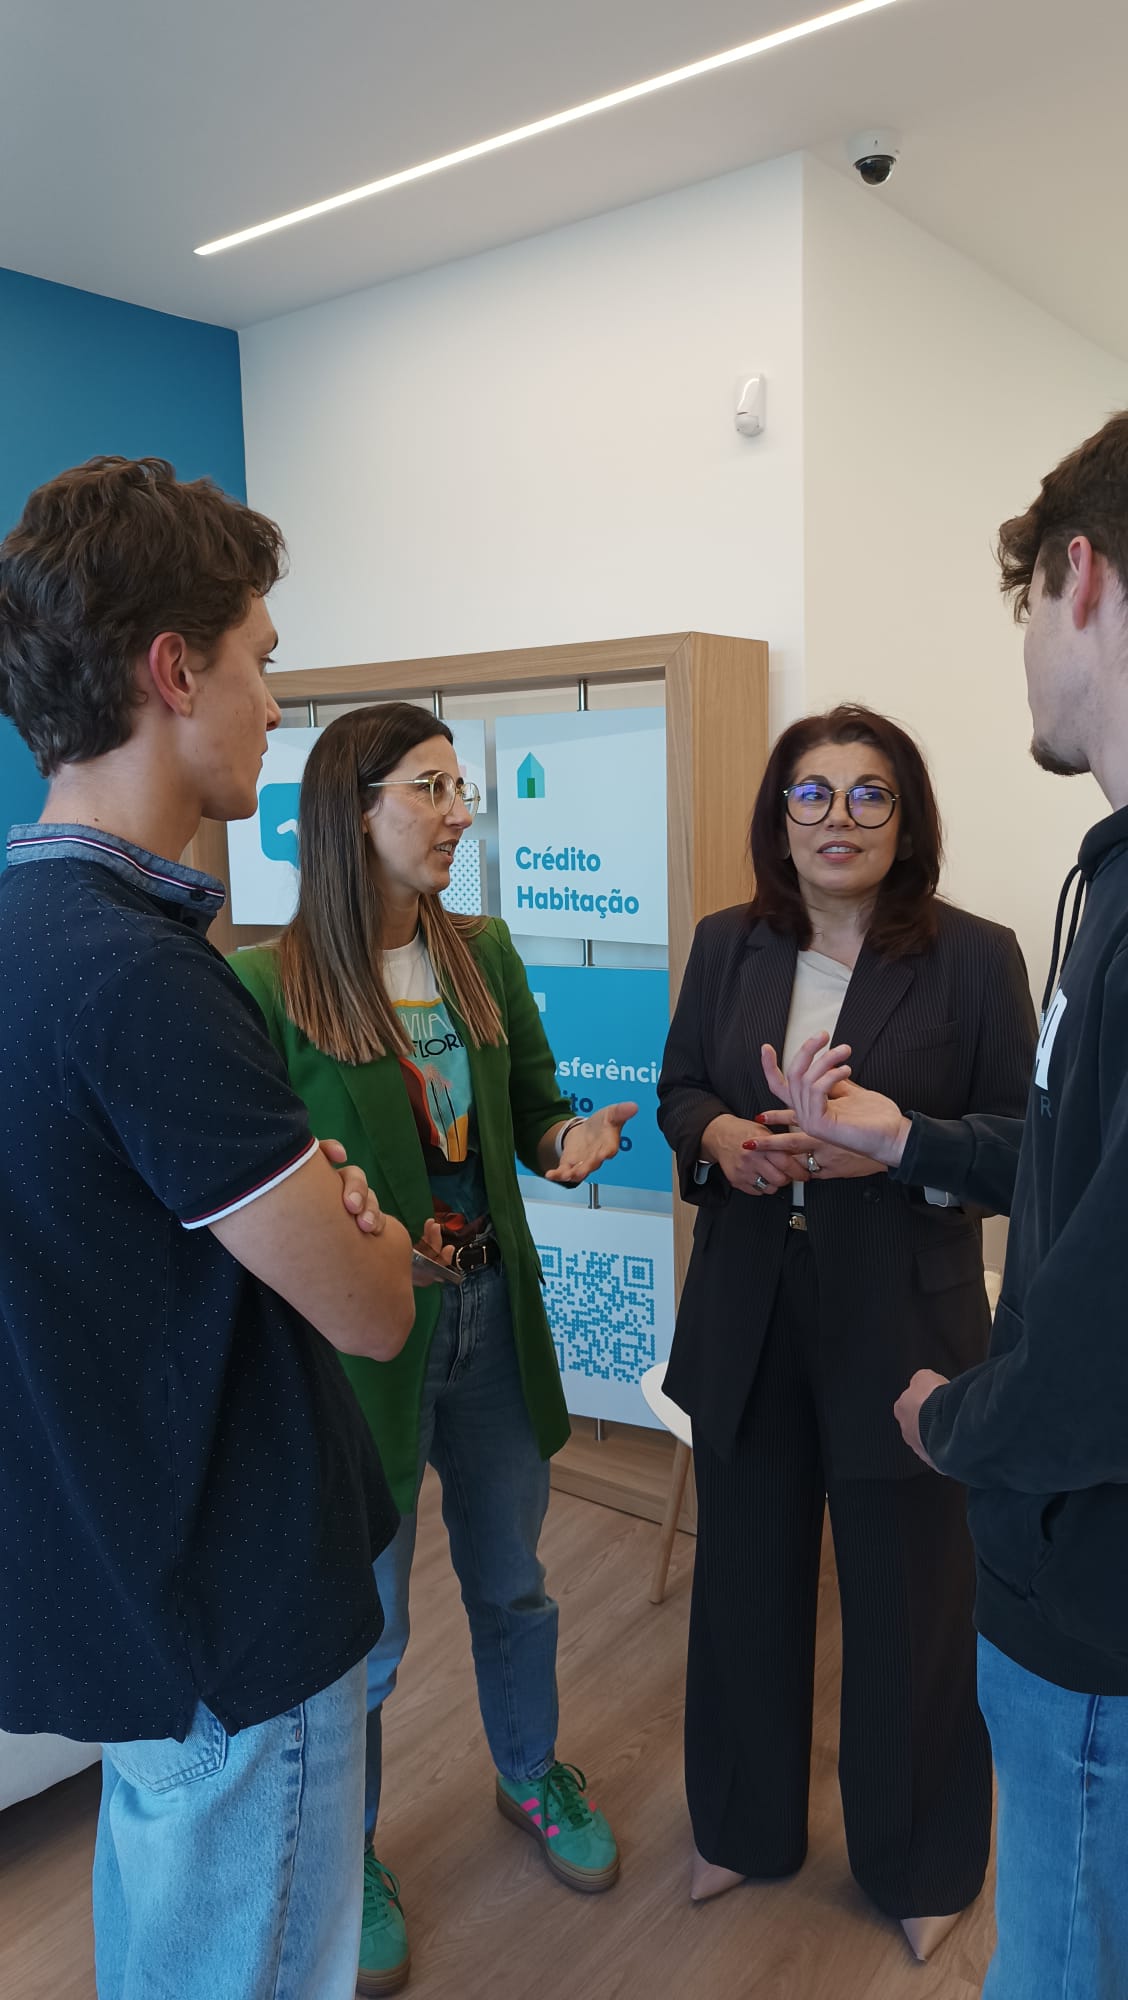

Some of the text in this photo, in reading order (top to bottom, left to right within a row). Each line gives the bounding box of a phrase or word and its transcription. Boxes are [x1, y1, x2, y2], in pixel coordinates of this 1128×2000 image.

[515, 846, 601, 872] Crédito
[516, 885, 639, 919] Habitação
[554, 1056, 662, 1084] sferênci
